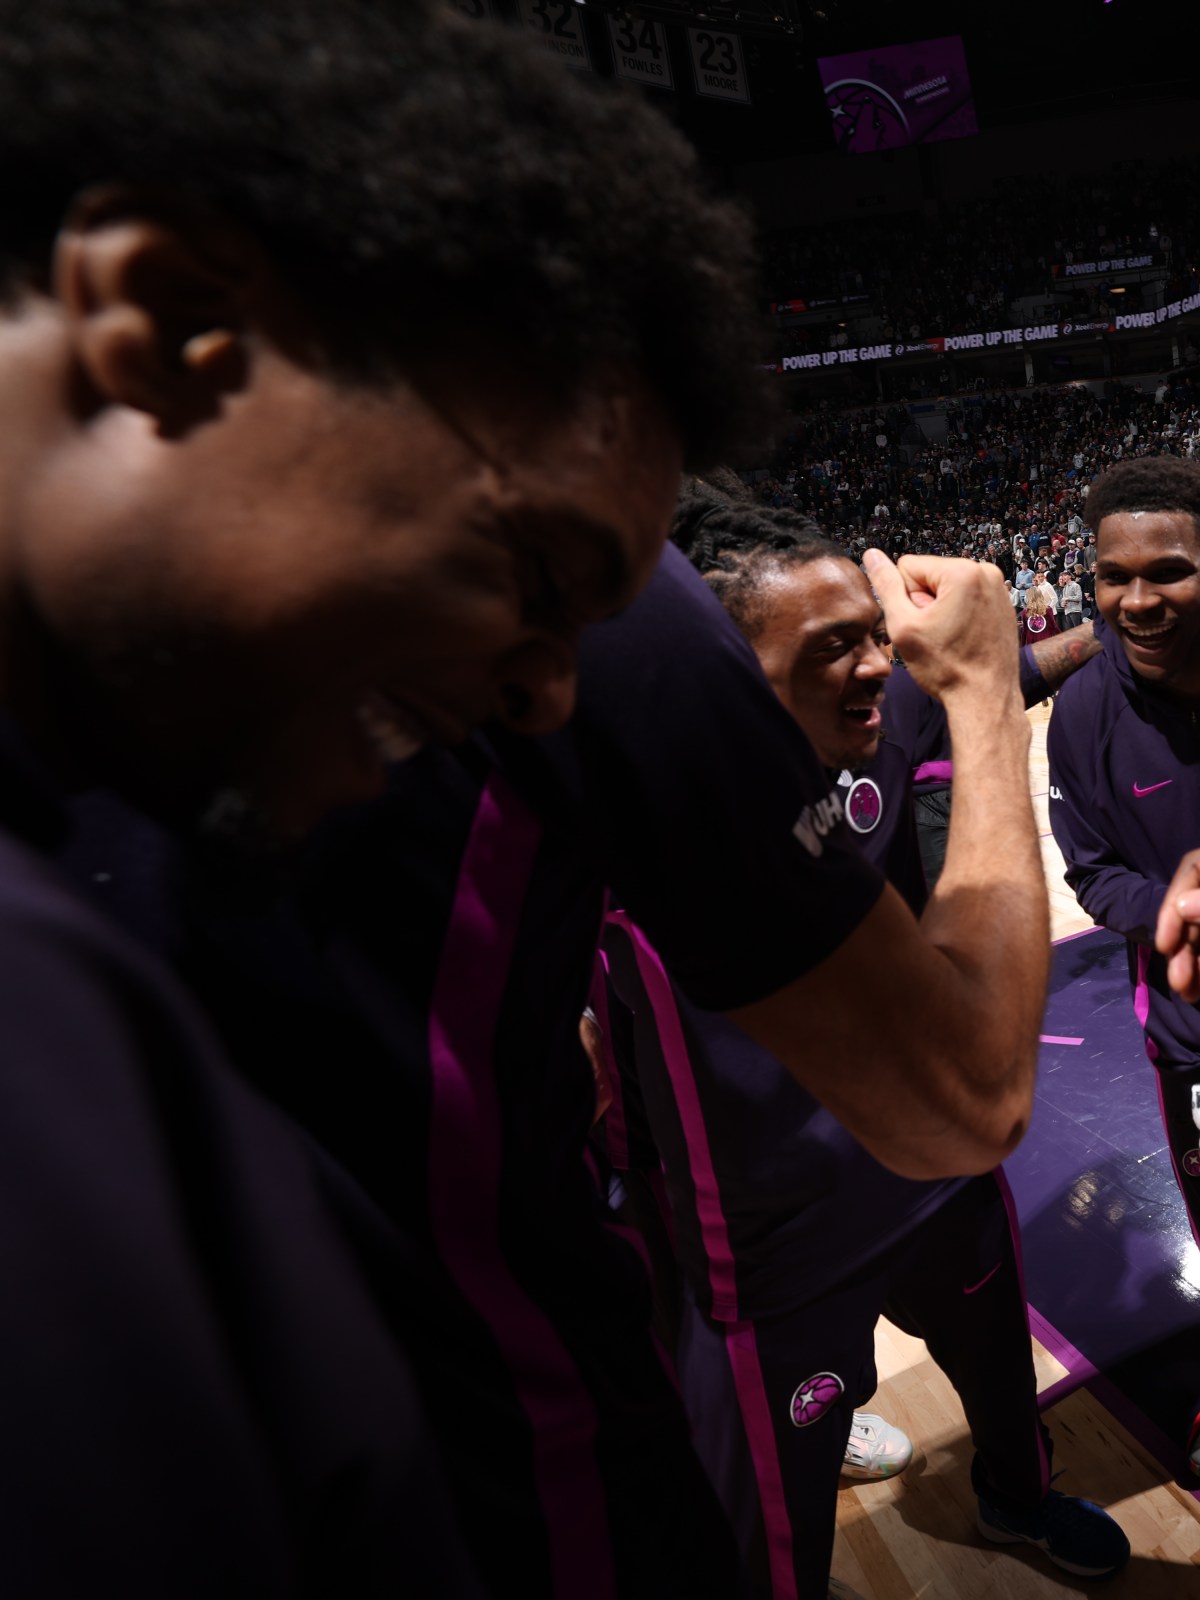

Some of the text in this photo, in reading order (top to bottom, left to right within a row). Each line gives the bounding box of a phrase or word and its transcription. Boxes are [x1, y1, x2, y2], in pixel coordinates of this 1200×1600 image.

[616, 20, 662, 59] 34
[622, 55, 663, 76] FOWLES
[696, 32, 737, 75] 23
[704, 74, 738, 92] MOORE
[1065, 256, 1153, 276] POWER UP THE GAME
[1115, 312, 1155, 329] POWER
[1156, 306, 1168, 322] UP
[1167, 301, 1182, 318] THE
[944, 324, 1058, 350] POWER UP THE GAME
[782, 353, 821, 371] POWER
[822, 351, 838, 365] UP
[837, 349, 858, 363] THE
[859, 344, 892, 360] GAME
[813, 790, 844, 837] UH
